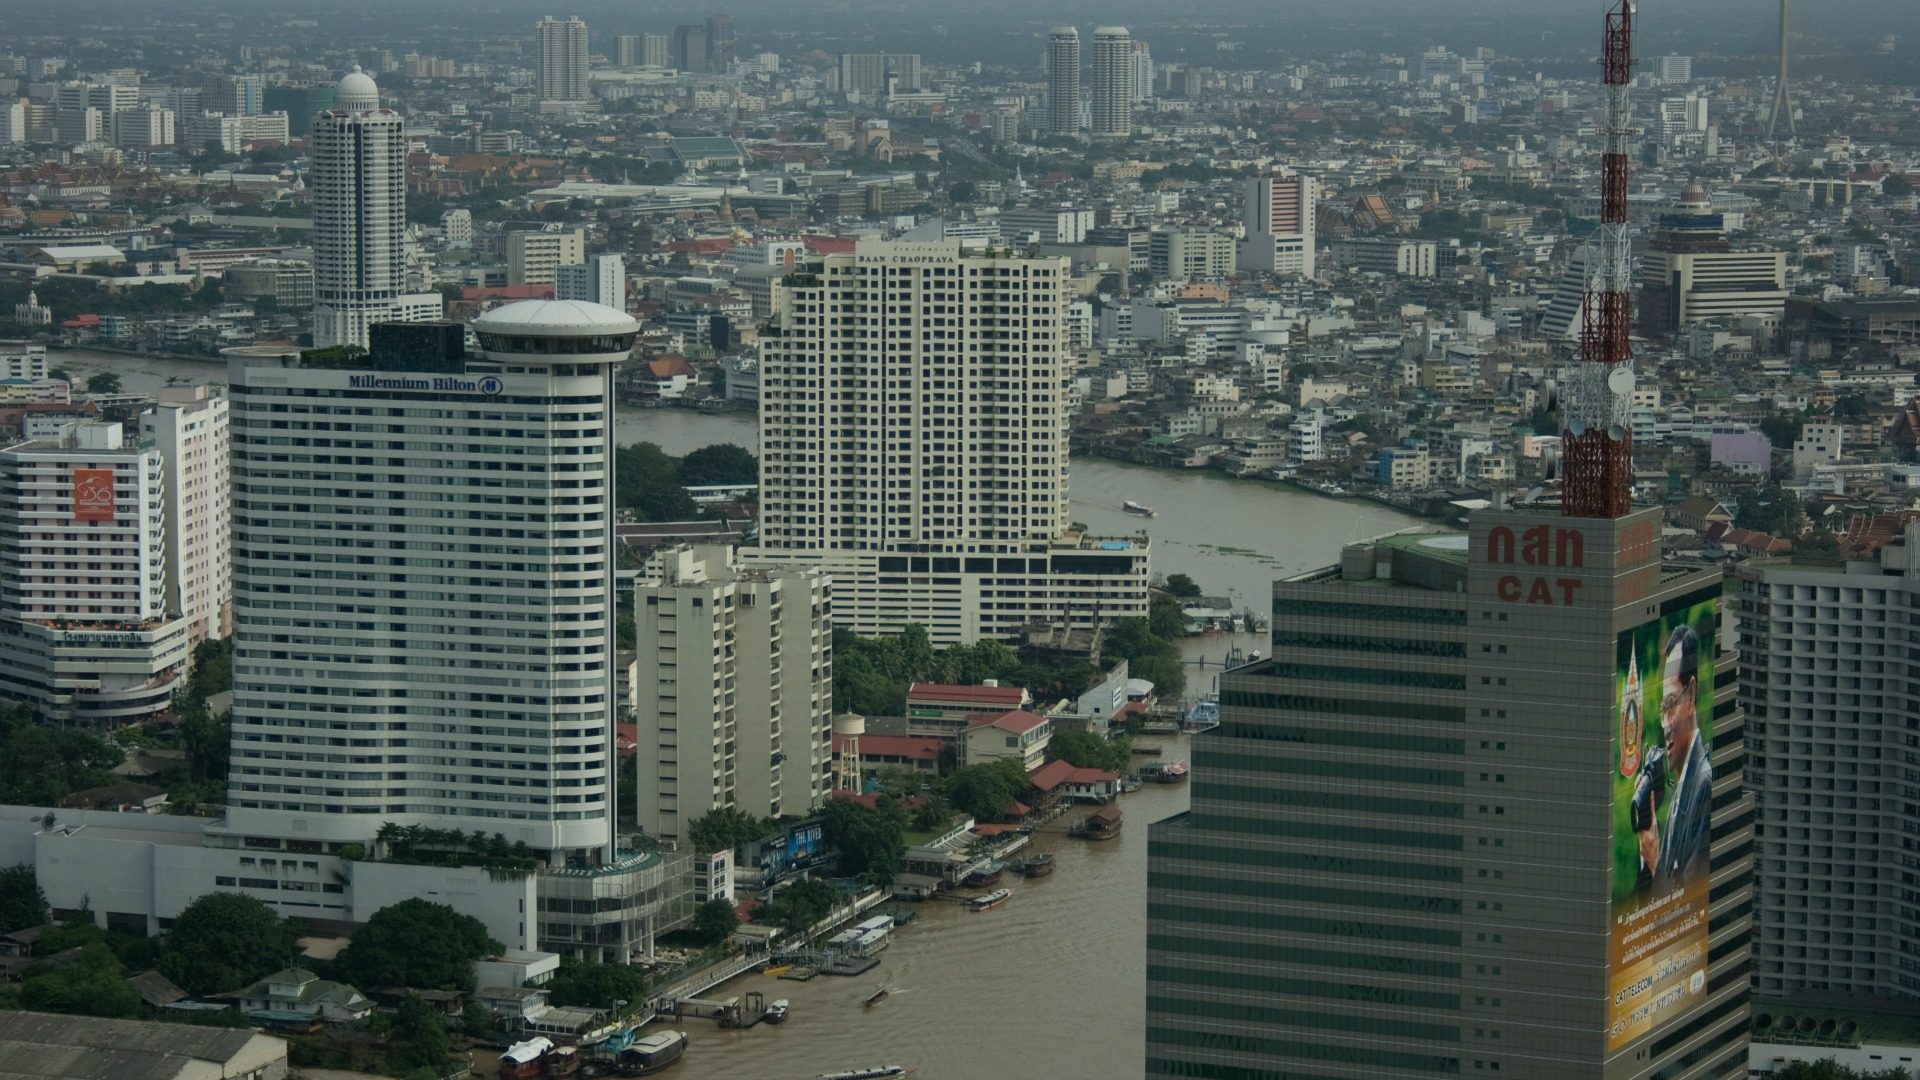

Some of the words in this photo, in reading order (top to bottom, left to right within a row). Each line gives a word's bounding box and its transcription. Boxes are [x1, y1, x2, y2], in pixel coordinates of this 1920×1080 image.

[349, 375, 429, 389] Millennium
[433, 378, 476, 391] Hilton
[1488, 525, 1584, 568] กสท
[1497, 575, 1582, 606] CAT
[795, 831, 806, 845] THE
[1615, 989, 1626, 1005] CAT
[1628, 975, 1653, 997] TELECOM
